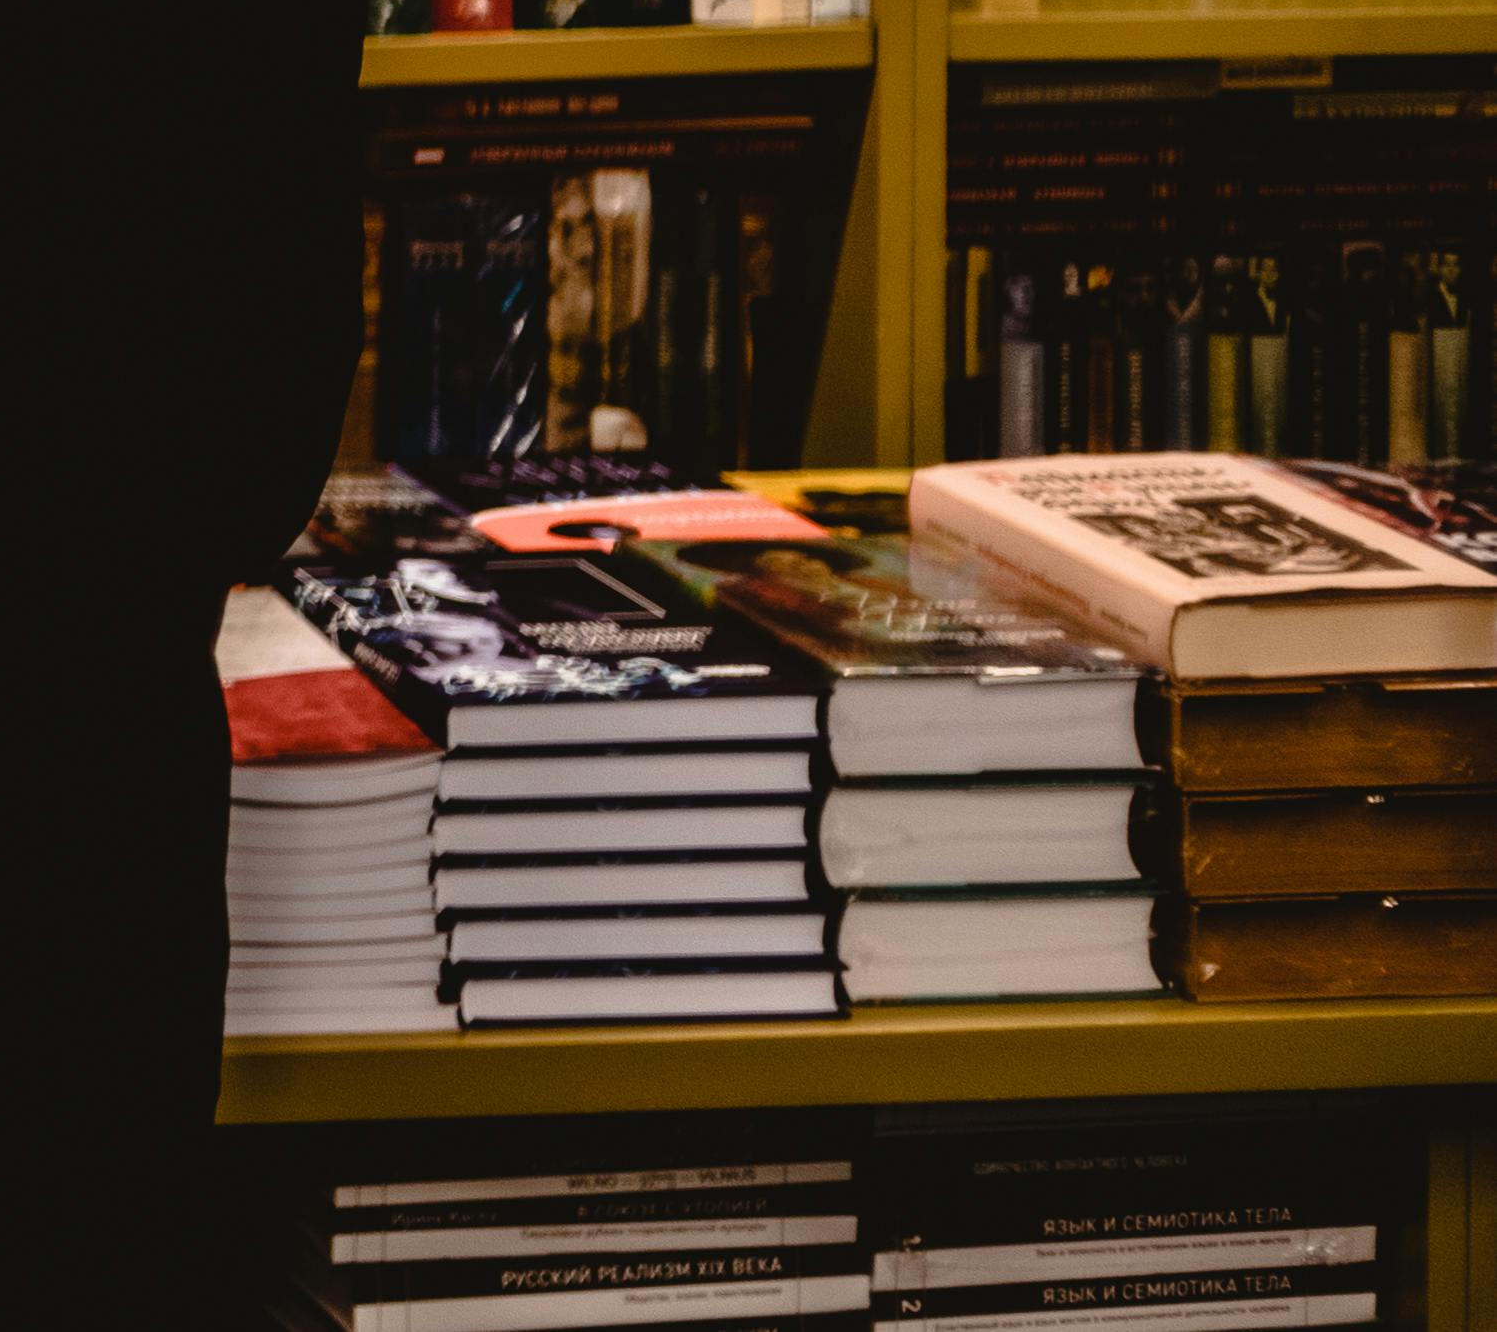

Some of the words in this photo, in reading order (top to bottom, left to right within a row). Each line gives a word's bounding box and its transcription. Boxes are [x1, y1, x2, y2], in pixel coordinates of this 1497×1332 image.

[1042, 1215, 1097, 1238] ЯЗЫК
[1103, 1215, 1119, 1234] И
[1121, 1209, 1238, 1234] СЕМИОТИКА
[1244, 1205, 1293, 1227] ТЕЛА
[499, 1265, 592, 1290] РУССКИЙ
[596, 1261, 693, 1286] РЕАЛИЗМ
[697, 1258, 726, 1279] XIX
[731, 1255, 784, 1278] ВЕКА
[901, 1299, 922, 1313] 2
[1042, 1285, 1097, 1306] ЯЗЫК
[1103, 1283, 1119, 1303] И
[1122, 1278, 1238, 1302] СЕМИОТИКА
[1244, 1273, 1293, 1296] ТЕЛА
